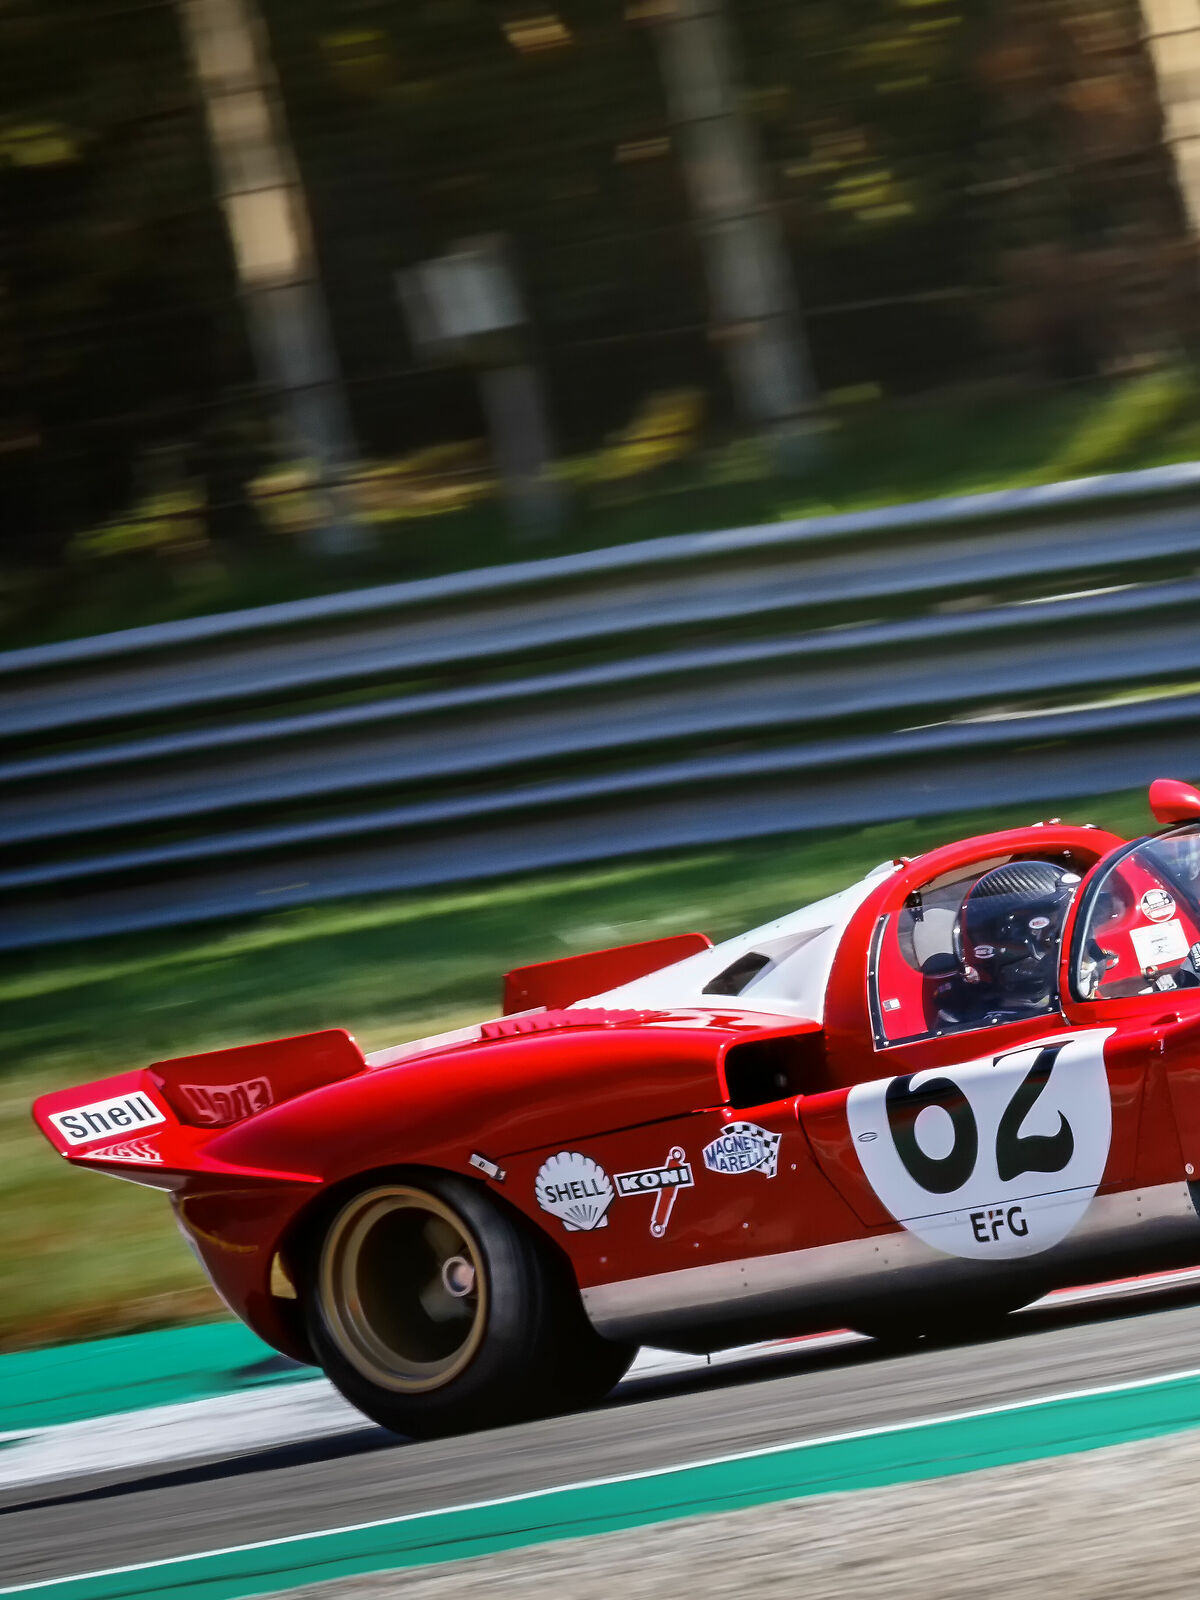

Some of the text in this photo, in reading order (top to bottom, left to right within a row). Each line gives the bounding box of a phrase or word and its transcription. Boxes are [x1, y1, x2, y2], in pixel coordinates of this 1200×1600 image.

[59, 1096, 156, 1138] Shell
[885, 1040, 1075, 1194] 62
[705, 1136, 765, 1158] MAGNETI
[544, 1178, 607, 1204] SHELL
[621, 1167, 689, 1192] KONI
[969, 1206, 1029, 1243] EFG
